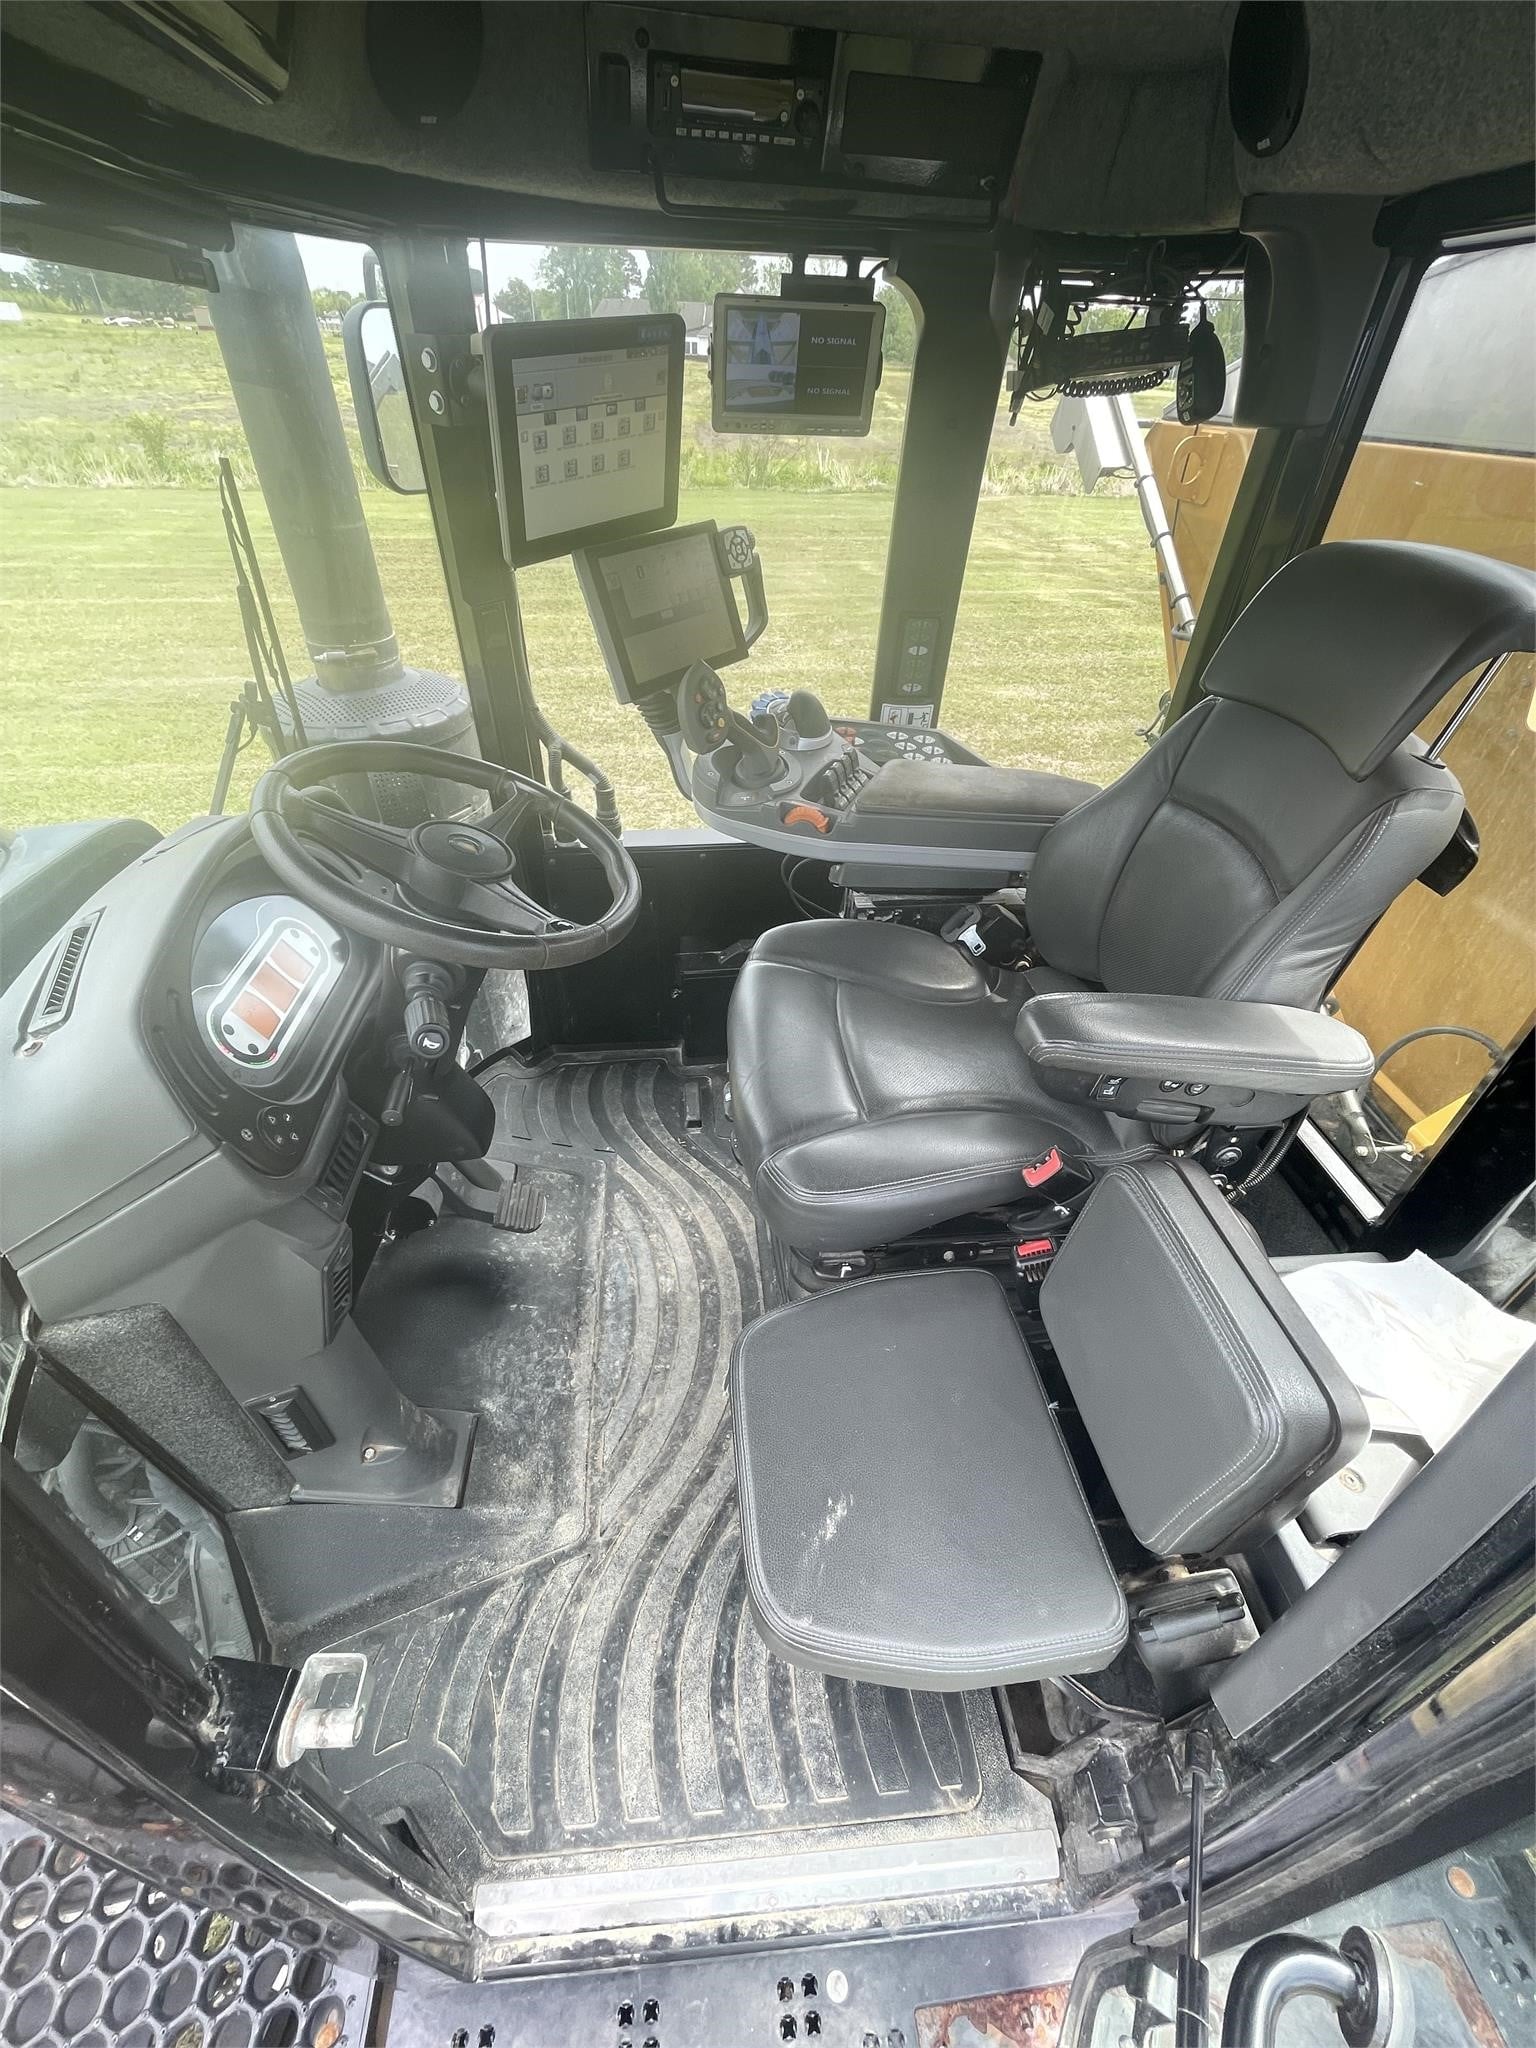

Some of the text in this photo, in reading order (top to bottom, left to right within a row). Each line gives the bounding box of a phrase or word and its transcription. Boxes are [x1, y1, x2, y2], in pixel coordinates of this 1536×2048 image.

[827, 337, 856, 345] SIGNAL
[807, 387, 850, 396] NO SIGNAL
